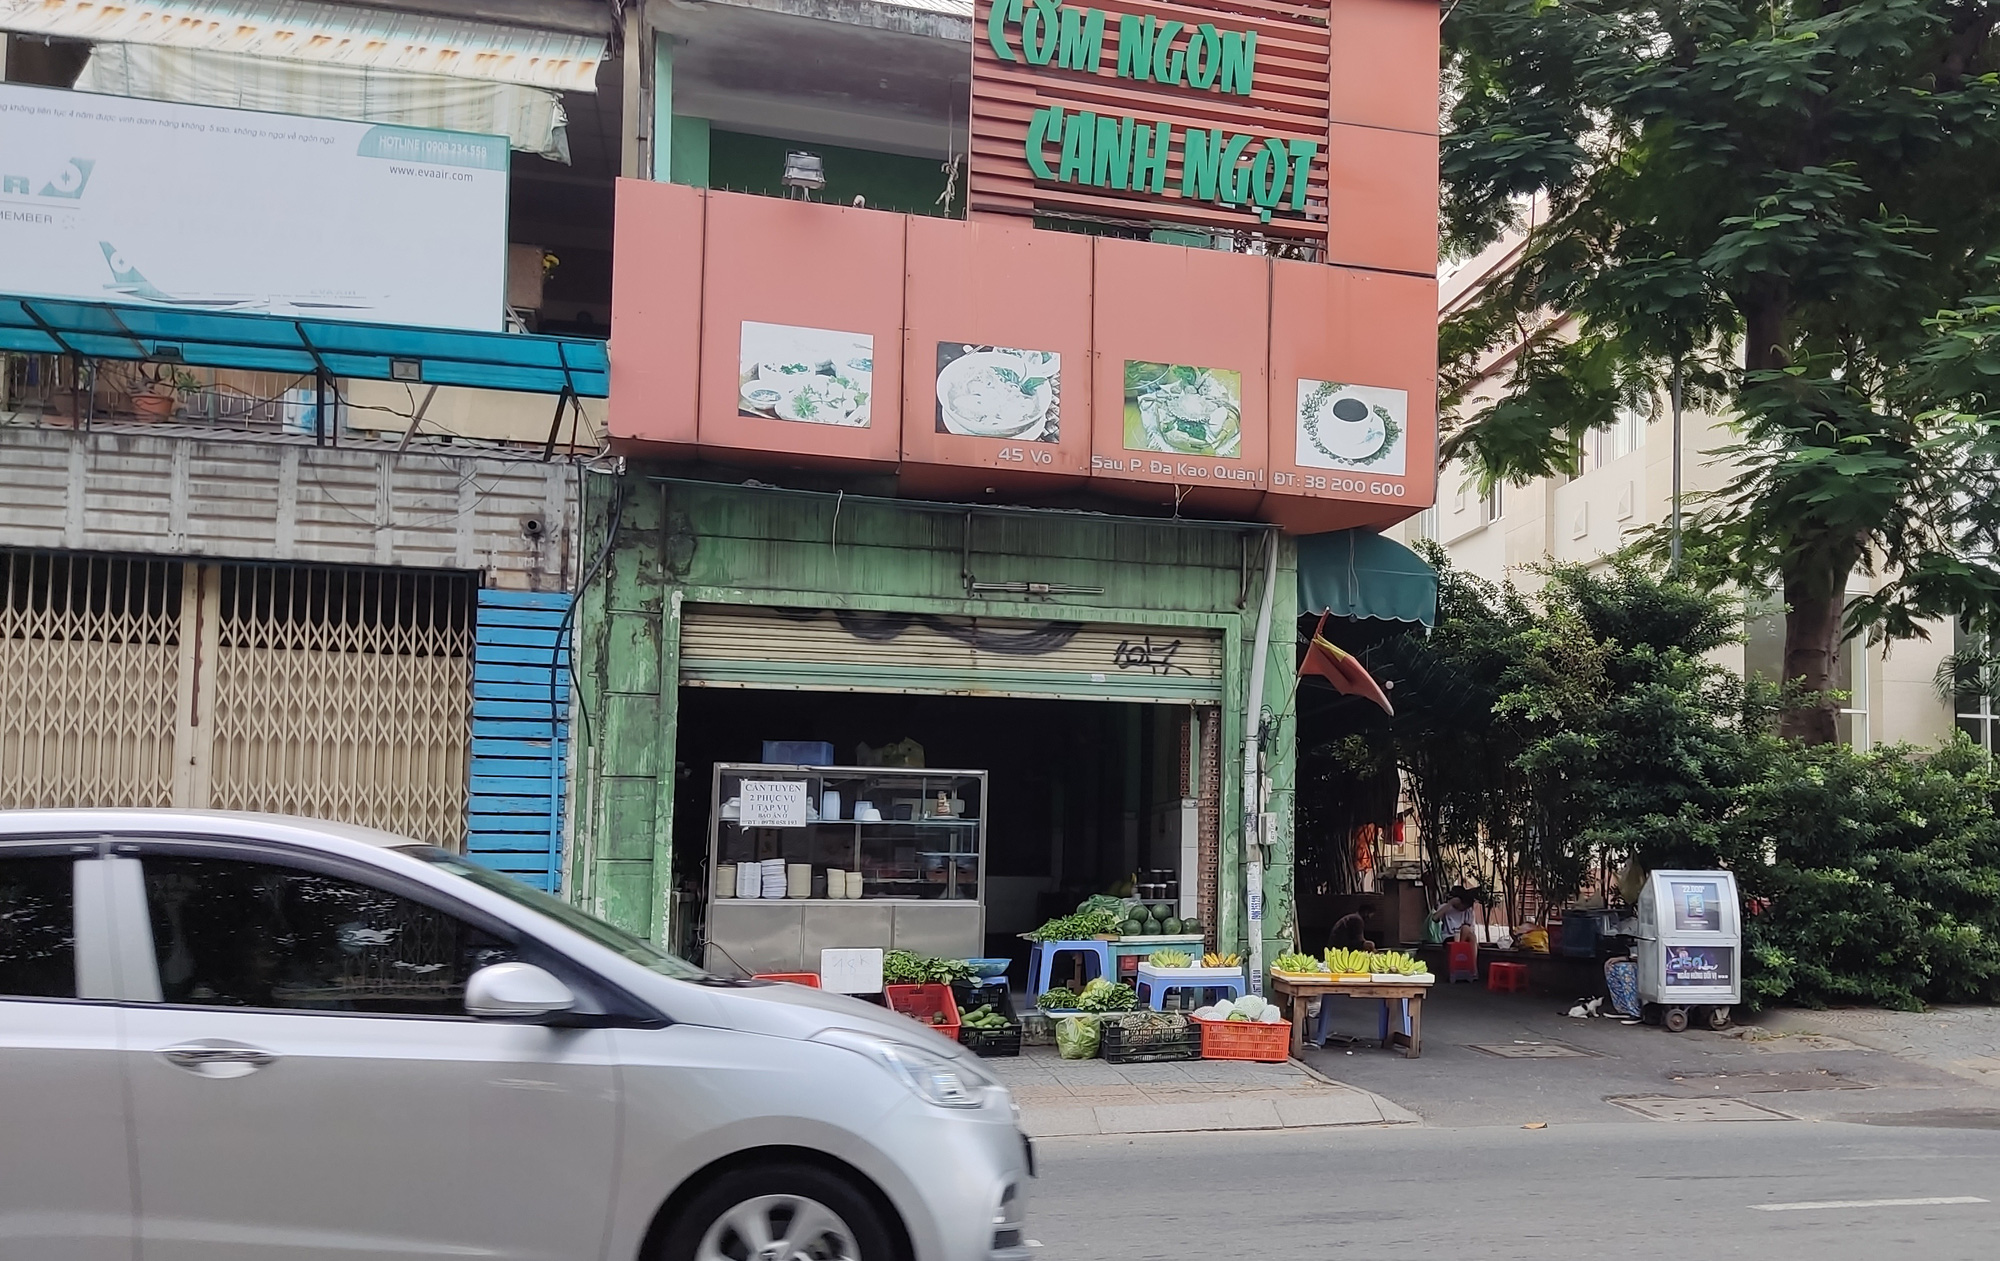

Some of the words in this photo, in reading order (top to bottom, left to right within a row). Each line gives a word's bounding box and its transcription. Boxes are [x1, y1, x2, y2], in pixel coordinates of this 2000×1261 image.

[379, 135, 420, 150] HOTLINE
[1025, 106, 1171, 194] CANH
[1182, 128, 1318, 223] NGỌT
[389, 165, 473, 182] www.evaair.com
[998, 447, 1024, 462] 45
[1130, 458, 1146, 473] P.
[1150, 460, 1173, 475] Đa
[1214, 465, 1256, 483] Quận
[1304, 475, 1327, 489] 38
[1330, 477, 1366, 493] 200
[1370, 481, 1405, 497] 600
[757, 794, 782, 803] PHỤC
[784, 794, 796, 803] VỤ
